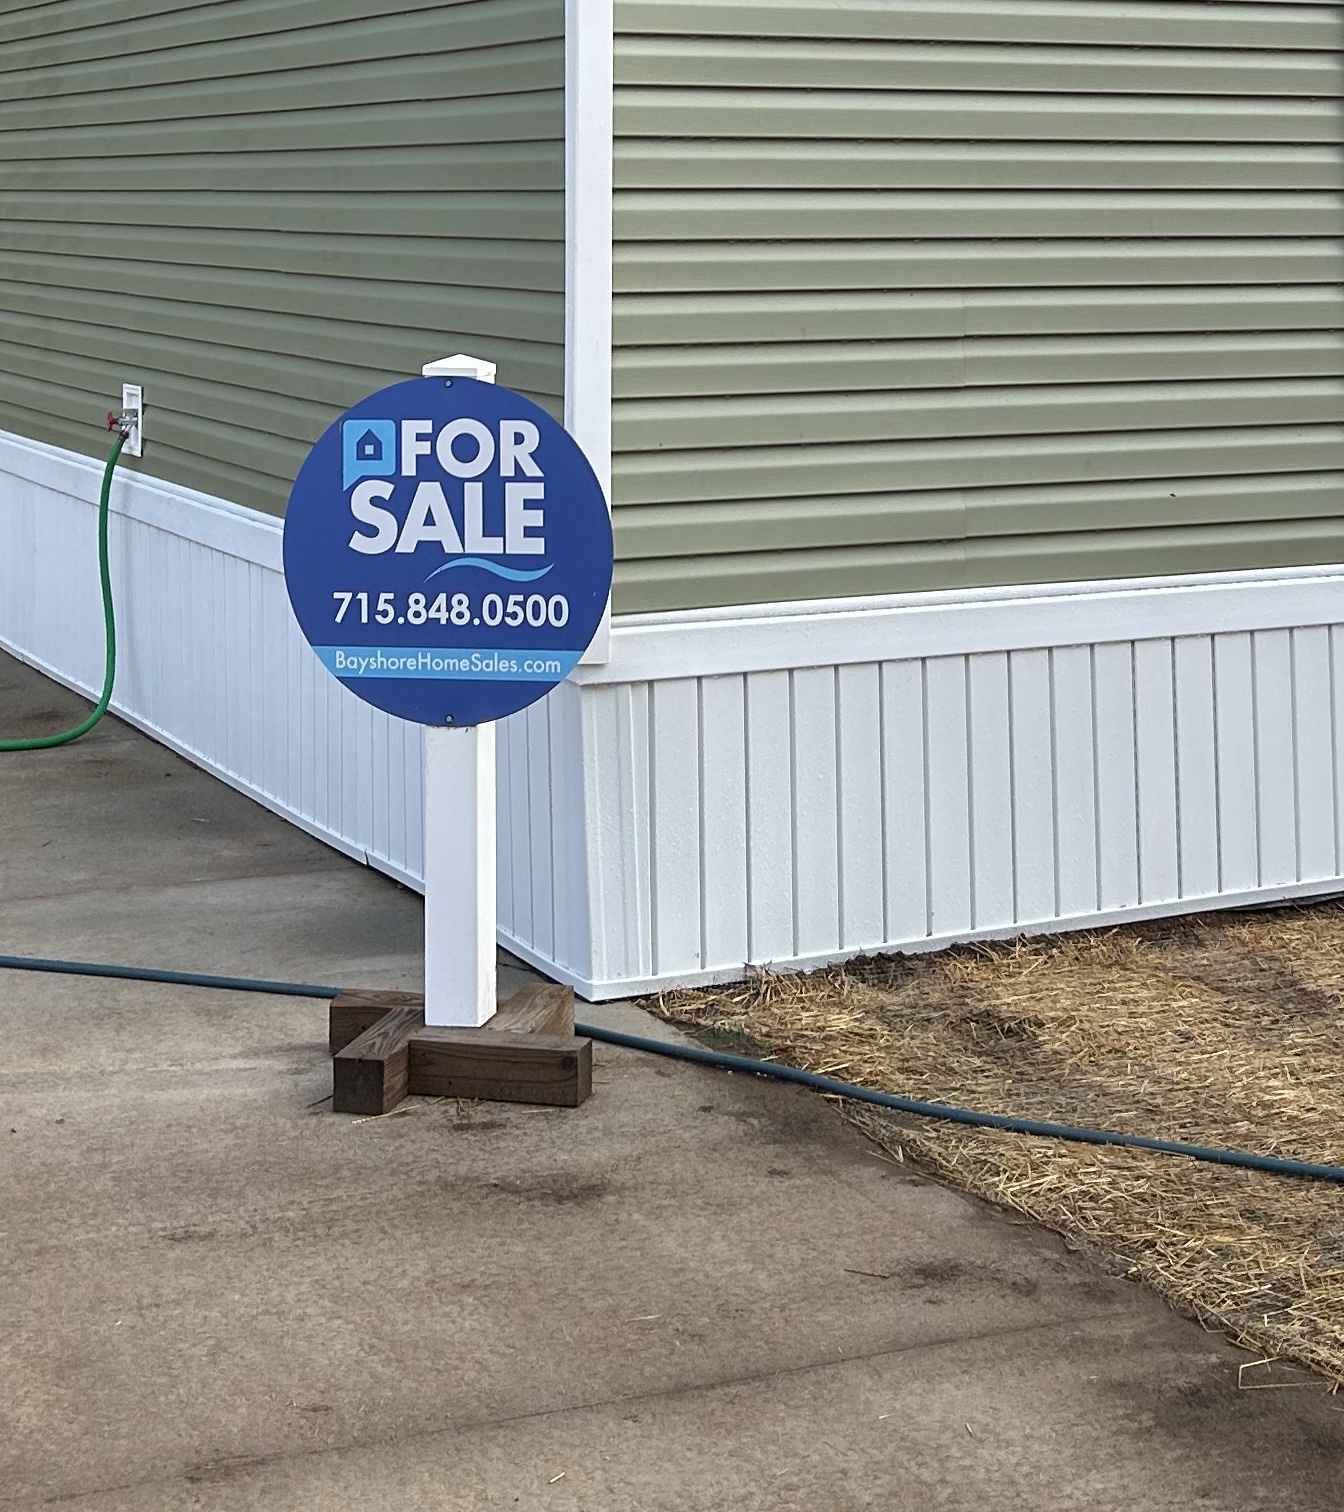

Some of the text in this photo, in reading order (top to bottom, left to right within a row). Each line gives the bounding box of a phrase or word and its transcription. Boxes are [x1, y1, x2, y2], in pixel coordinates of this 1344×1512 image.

[400, 417, 545, 479] FOR
[348, 479, 545, 555] SALE
[332, 591, 570, 628] 715.848.0500
[335, 650, 561, 676] BayshoreHomeSales.com
